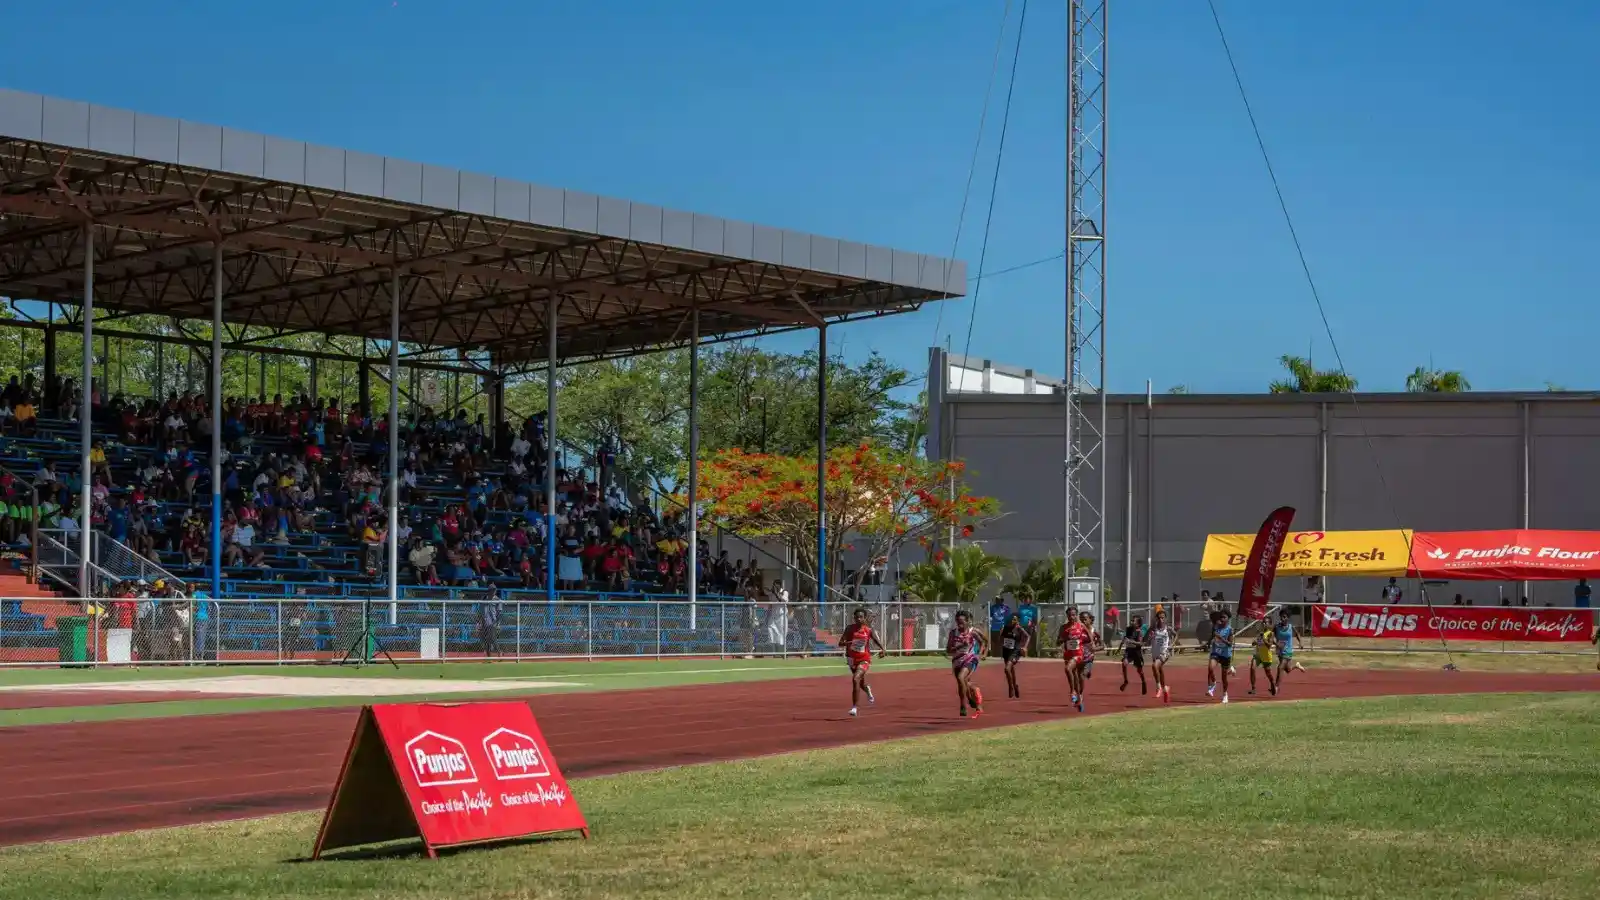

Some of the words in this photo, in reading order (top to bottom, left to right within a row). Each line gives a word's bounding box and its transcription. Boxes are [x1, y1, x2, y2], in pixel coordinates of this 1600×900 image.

[1227, 548, 1312, 565] Bers
[1319, 547, 1386, 561] Fresh
[1456, 544, 1532, 559] Punjas
[1537, 547, 1600, 559] Flour
[1320, 606, 1419, 636] Punjas
[1428, 615, 1477, 631] Choice
[1482, 616, 1498, 631] of
[1500, 617, 1522, 631] the
[1525, 613, 1584, 638] Pacific
[414, 746, 466, 779] Punjas
[491, 742, 539, 773] Punjas
[421, 799, 445, 815] Choice
[445, 799, 453, 812] of
[453, 799, 465, 812] the
[462, 787, 493, 816] Pacific
[500, 792, 523, 807] Choice
[522, 791, 530, 804] of
[528, 791, 540, 803] the
[536, 781, 566, 807] Pacific
